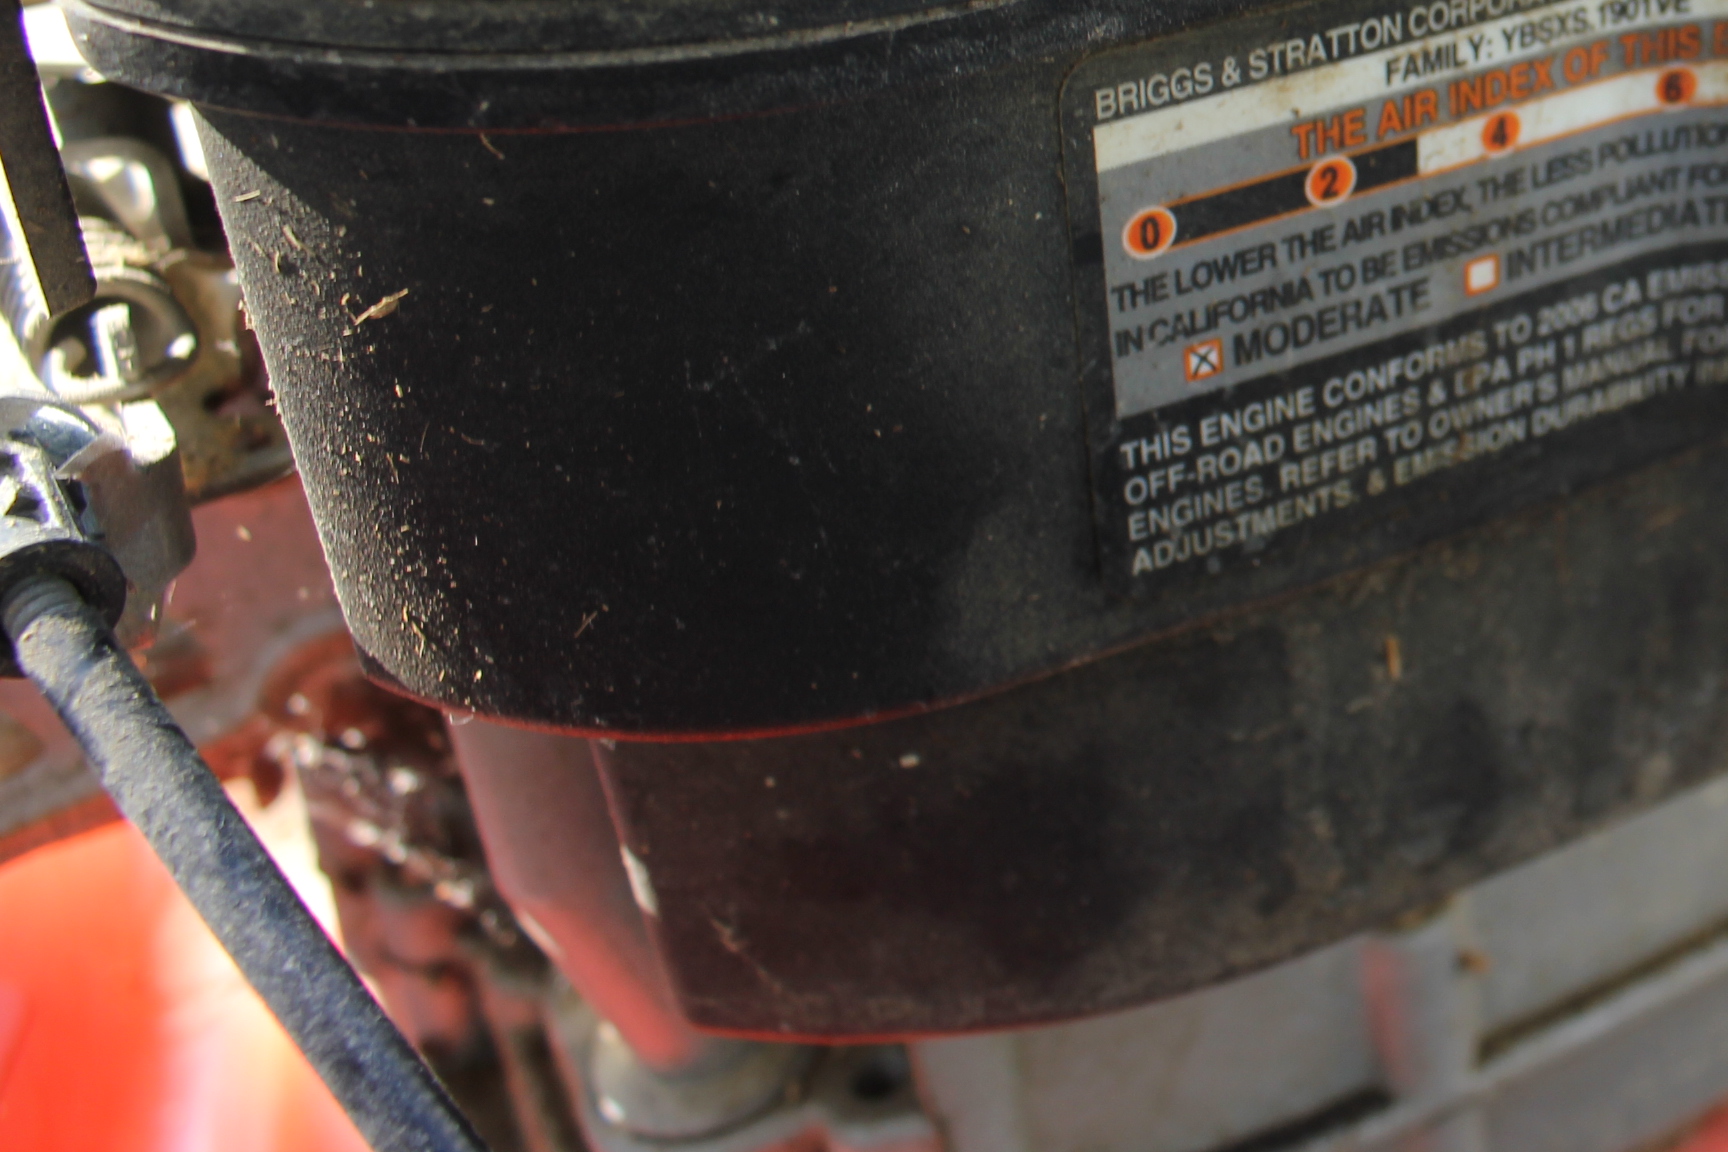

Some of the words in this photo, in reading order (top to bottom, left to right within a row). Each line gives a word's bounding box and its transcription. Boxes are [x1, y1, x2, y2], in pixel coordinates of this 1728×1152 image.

[1094, 56, 1214, 120] BRIGGS
[1221, 57, 1242, 89] &
[1248, 14, 1403, 78] STRATTON
[1292, 105, 1367, 159] THE
[1376, 89, 1439, 137] AIR
[1449, 56, 1556, 116] INDEX
[1563, 38, 1612, 84] OF
[1619, 23, 1700, 68] THIS
[1384, 36, 1495, 88] FAMILY:
[1111, 274, 1169, 313] THE
[1174, 241, 1277, 296] LOWER
[1282, 222, 1336, 262] THE
[1341, 211, 1385, 248] AIR
[1477, 167, 1526, 204] THE
[1531, 148, 1593, 190] LESS
[1138, 216, 1161, 252] 0
[1319, 167, 1340, 200] 2
[1490, 118, 1510, 149] 4
[1116, 324, 1143, 359] IN
[1149, 277, 1313, 347] CALIFORNIA
[1318, 260, 1356, 299] TO
[1362, 245, 1397, 283] BE
[1403, 206, 1537, 271] EMISSIONS
[1542, 165, 1682, 226] COMPLIANT
[1233, 276, 1431, 367] MODERATE
[1120, 425, 1193, 472] THIS
[1199, 387, 1317, 448] ENGINE
[1323, 328, 1489, 407] CONFORMS
[1492, 313, 1533, 347] TO
[1601, 276, 1643, 315] CA
[1123, 436, 1286, 506] OFF-ROAD
[1292, 386, 1421, 454] ENGINES
[1515, 339, 1557, 377] PH
[1279, 434, 1378, 492] REFER
[1383, 418, 1423, 457] TO
[1561, 334, 1673, 395] MANUAL
[1366, 468, 1387, 496] &
[1394, 416, 1528, 486] EMISSION
